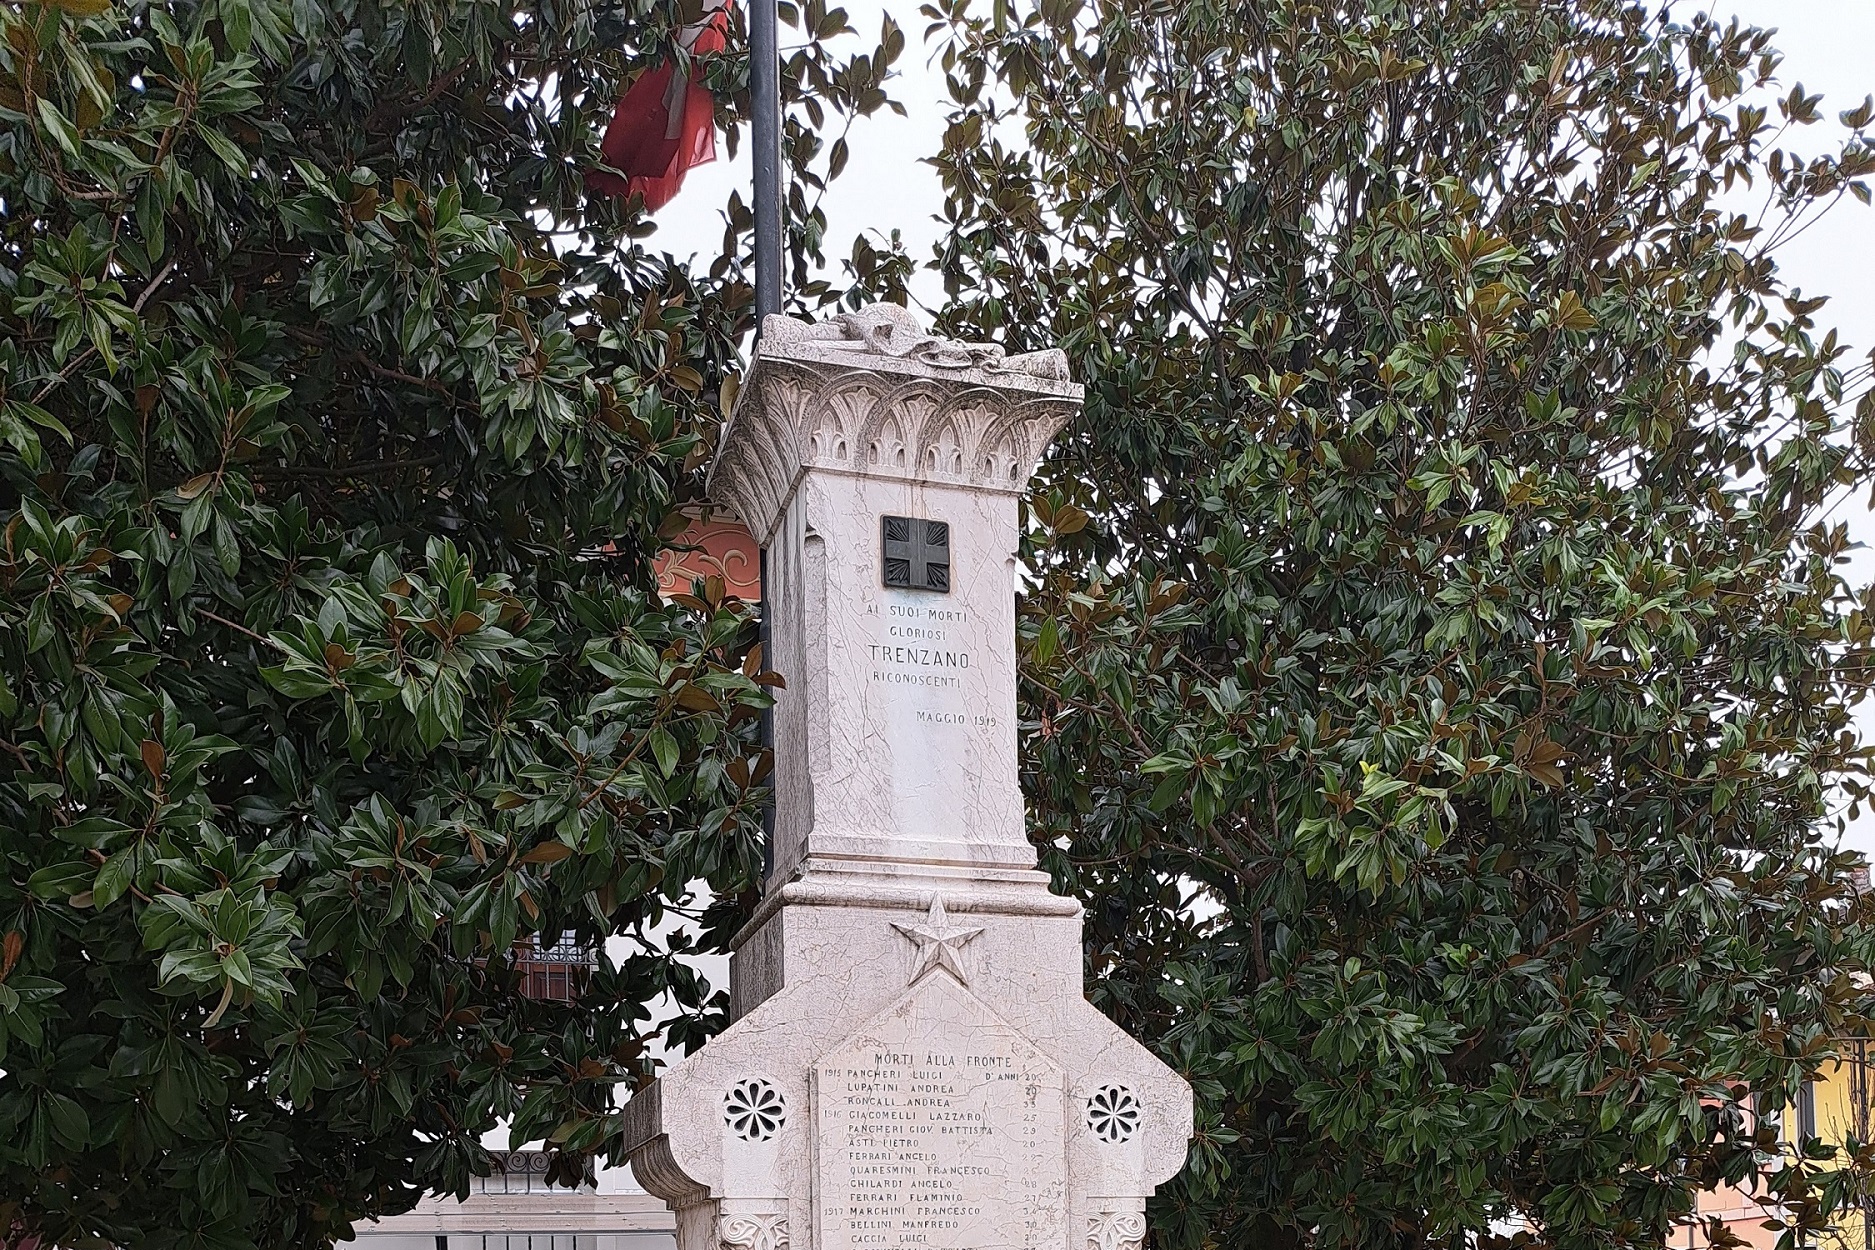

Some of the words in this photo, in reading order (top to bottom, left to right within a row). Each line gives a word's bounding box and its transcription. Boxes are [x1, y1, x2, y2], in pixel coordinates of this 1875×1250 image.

[890, 605, 919, 618] SUOI
[928, 609, 967, 623] MORTI
[890, 626, 946, 641] GLORIOSI
[868, 644, 969, 669] TRENZANO
[873, 671, 961, 689] RICONOSCENTI
[916, 711, 965, 724] MAGGIO
[974, 716, 996, 727] 1919
[874, 1054, 913, 1065] MORTI
[926, 1055, 955, 1066] ALLA
[967, 1056, 1012, 1067] FRONTE
[825, 1069, 841, 1077] 1915
[847, 1070, 901, 1079] PANCHERI
[998, 1073, 1019, 1081] ANNI
[1025, 1073, 1036, 1081] 20
[847, 1083, 898, 1092] LUPATINI
[910, 1085, 954, 1093] ANDREA
[906, 1099, 950, 1107] ANDREA
[849, 1110, 916, 1120] GIACOMELLI
[930, 1112, 981, 1121] LAZZARO
[1023, 1114, 1037, 1122] 25
[848, 1125, 903, 1134] PANCHERI
[941, 1126, 993, 1135] BATTISTA
[849, 1138, 873, 1147] ASTI
[883, 1139, 919, 1147] PIETRO
[1023, 1140, 1036, 1148] 20
[849, 1152, 891, 1160] FERRARI
[850, 1166, 916, 1175] QUARESMINI
[927, 1166, 990, 1175] FRANCESCO
[850, 1193, 897, 1202] FERRARI
[910, 1193, 963, 1202] FLAMINIO
[824, 1208, 843, 1216] 1917
[850, 1207, 905, 1215] MARCHINI
[917, 1207, 980, 1215] FRANCESCO
[851, 1221, 892, 1229] BELLINI
[903, 1220, 958, 1229] MANFREDO
